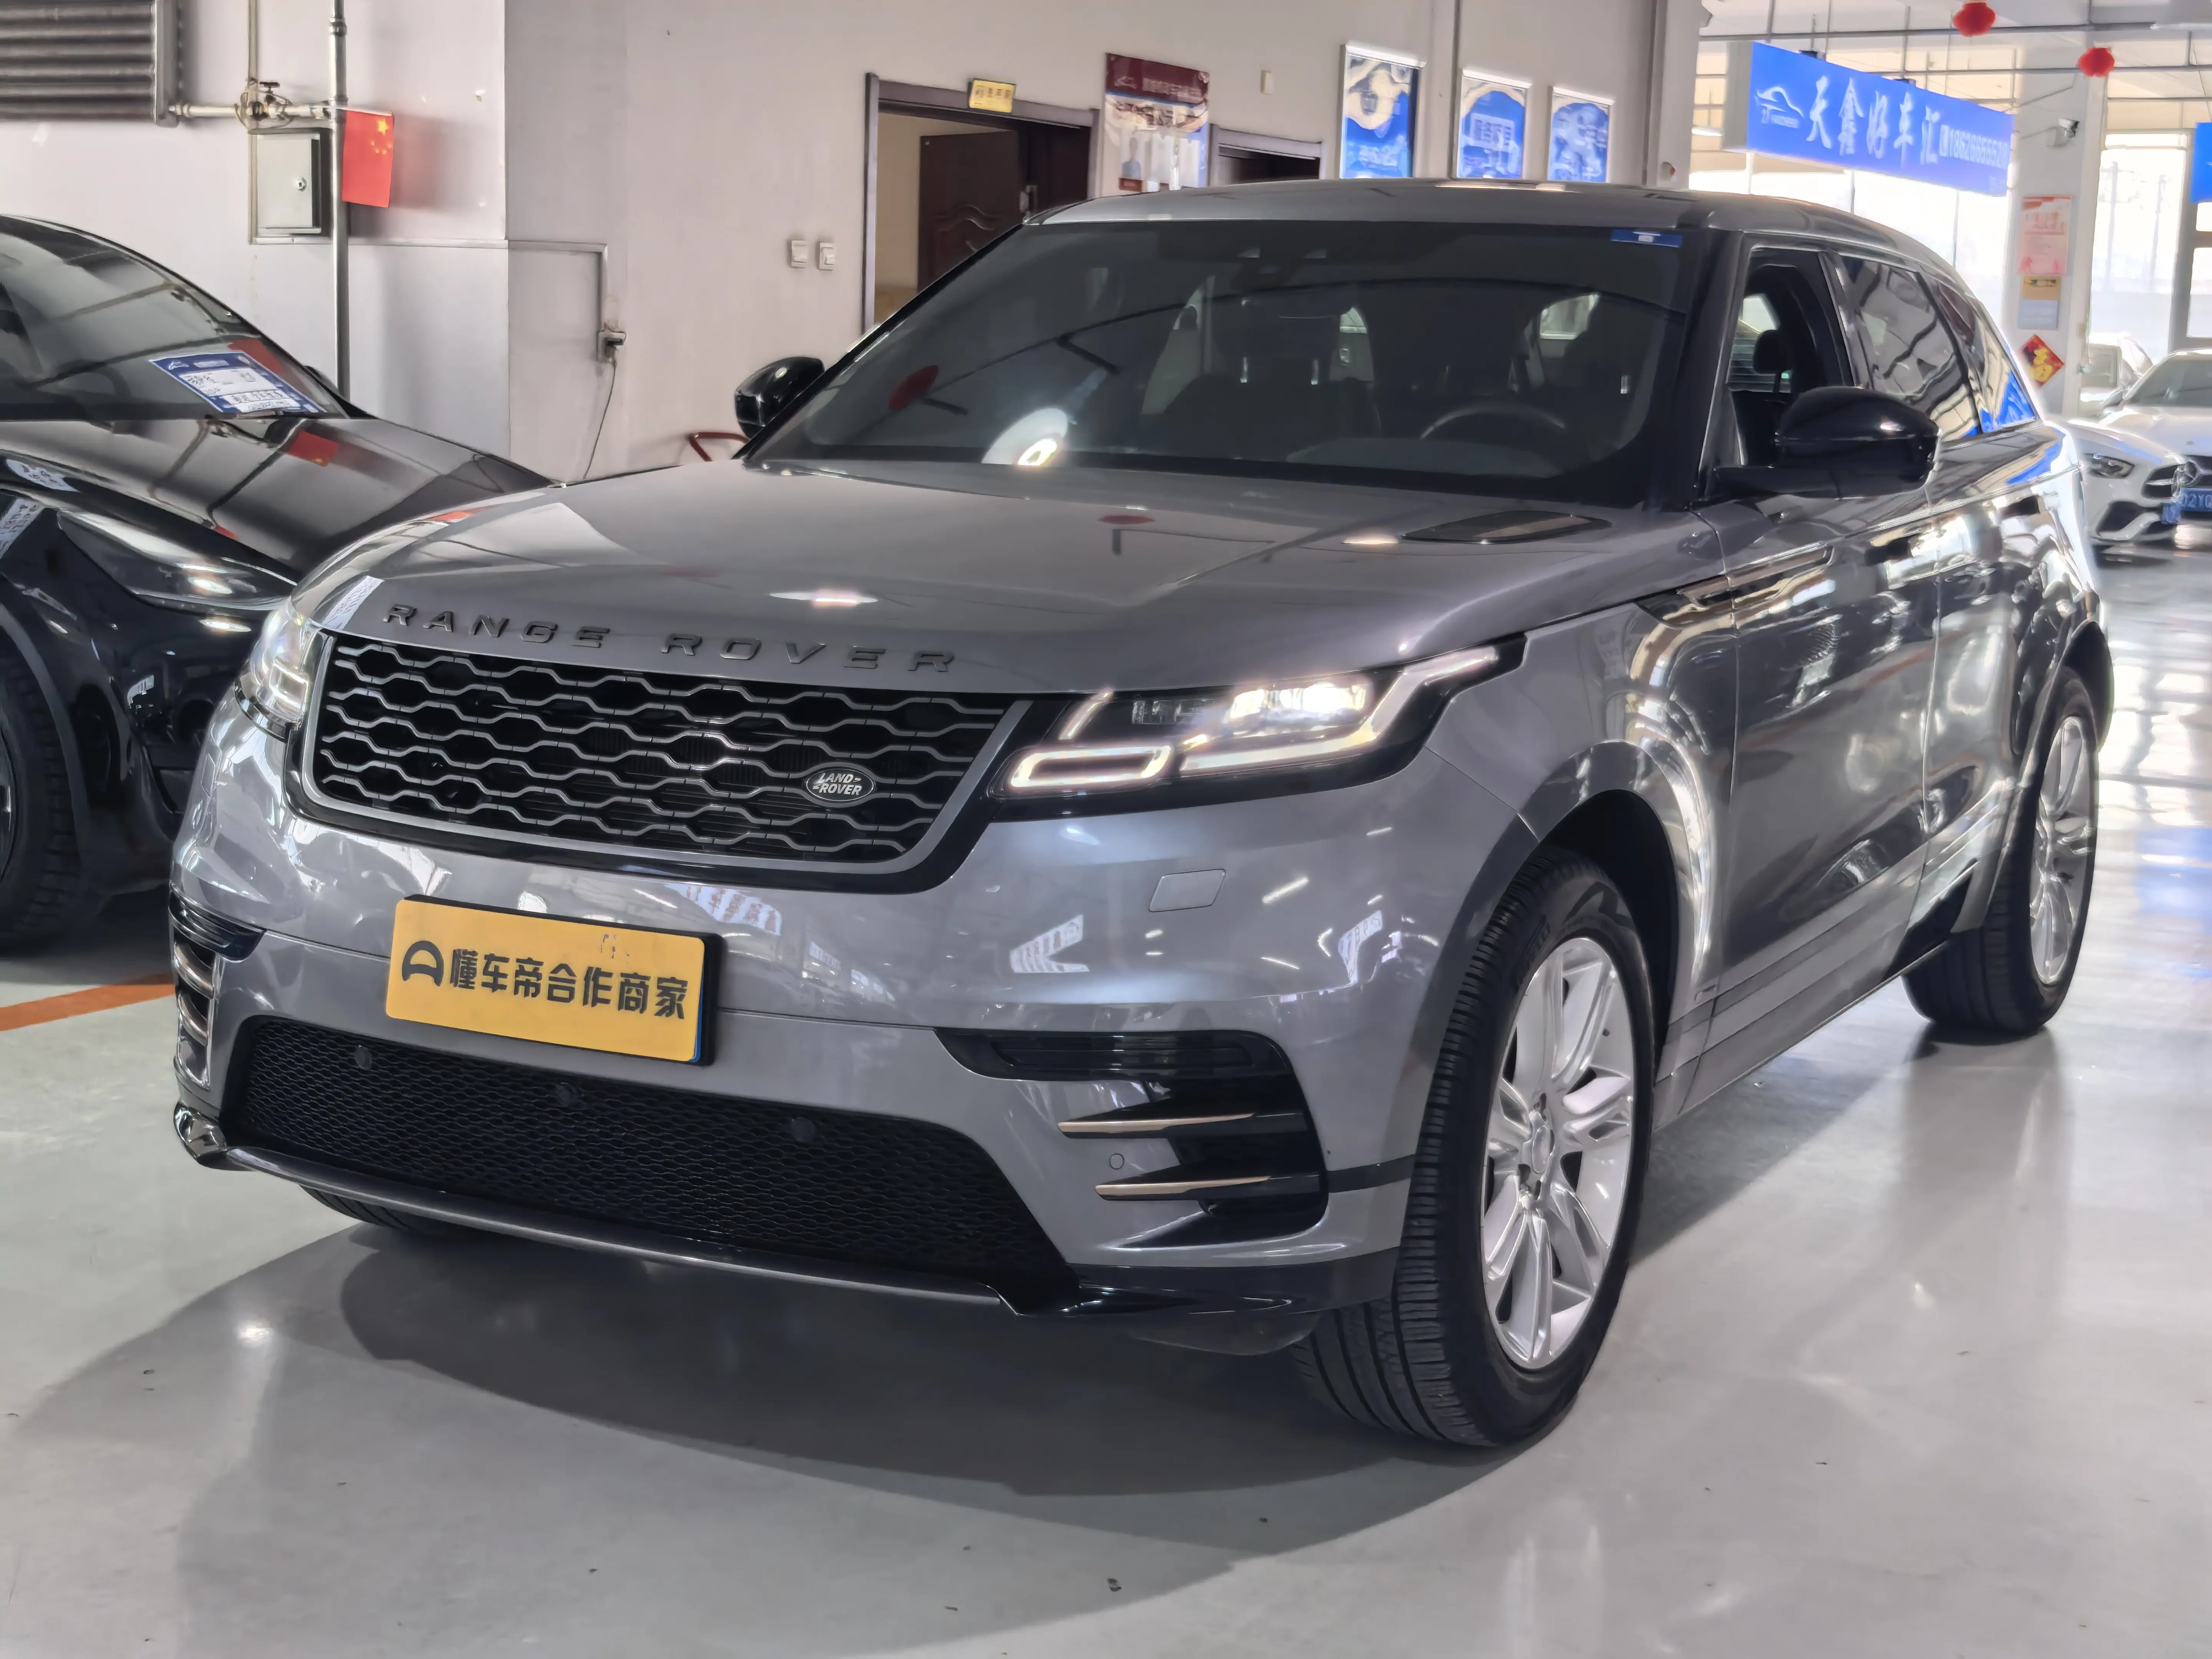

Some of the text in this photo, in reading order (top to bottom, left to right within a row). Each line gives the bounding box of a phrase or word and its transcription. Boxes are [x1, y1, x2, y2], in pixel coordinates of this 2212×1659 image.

[383, 603, 954, 672] RANGE ROVER
[817, 773, 854, 783] LAND
[819, 783, 862, 795] ROVER
[449, 948, 689, 1020] 懂车帝合作商家
